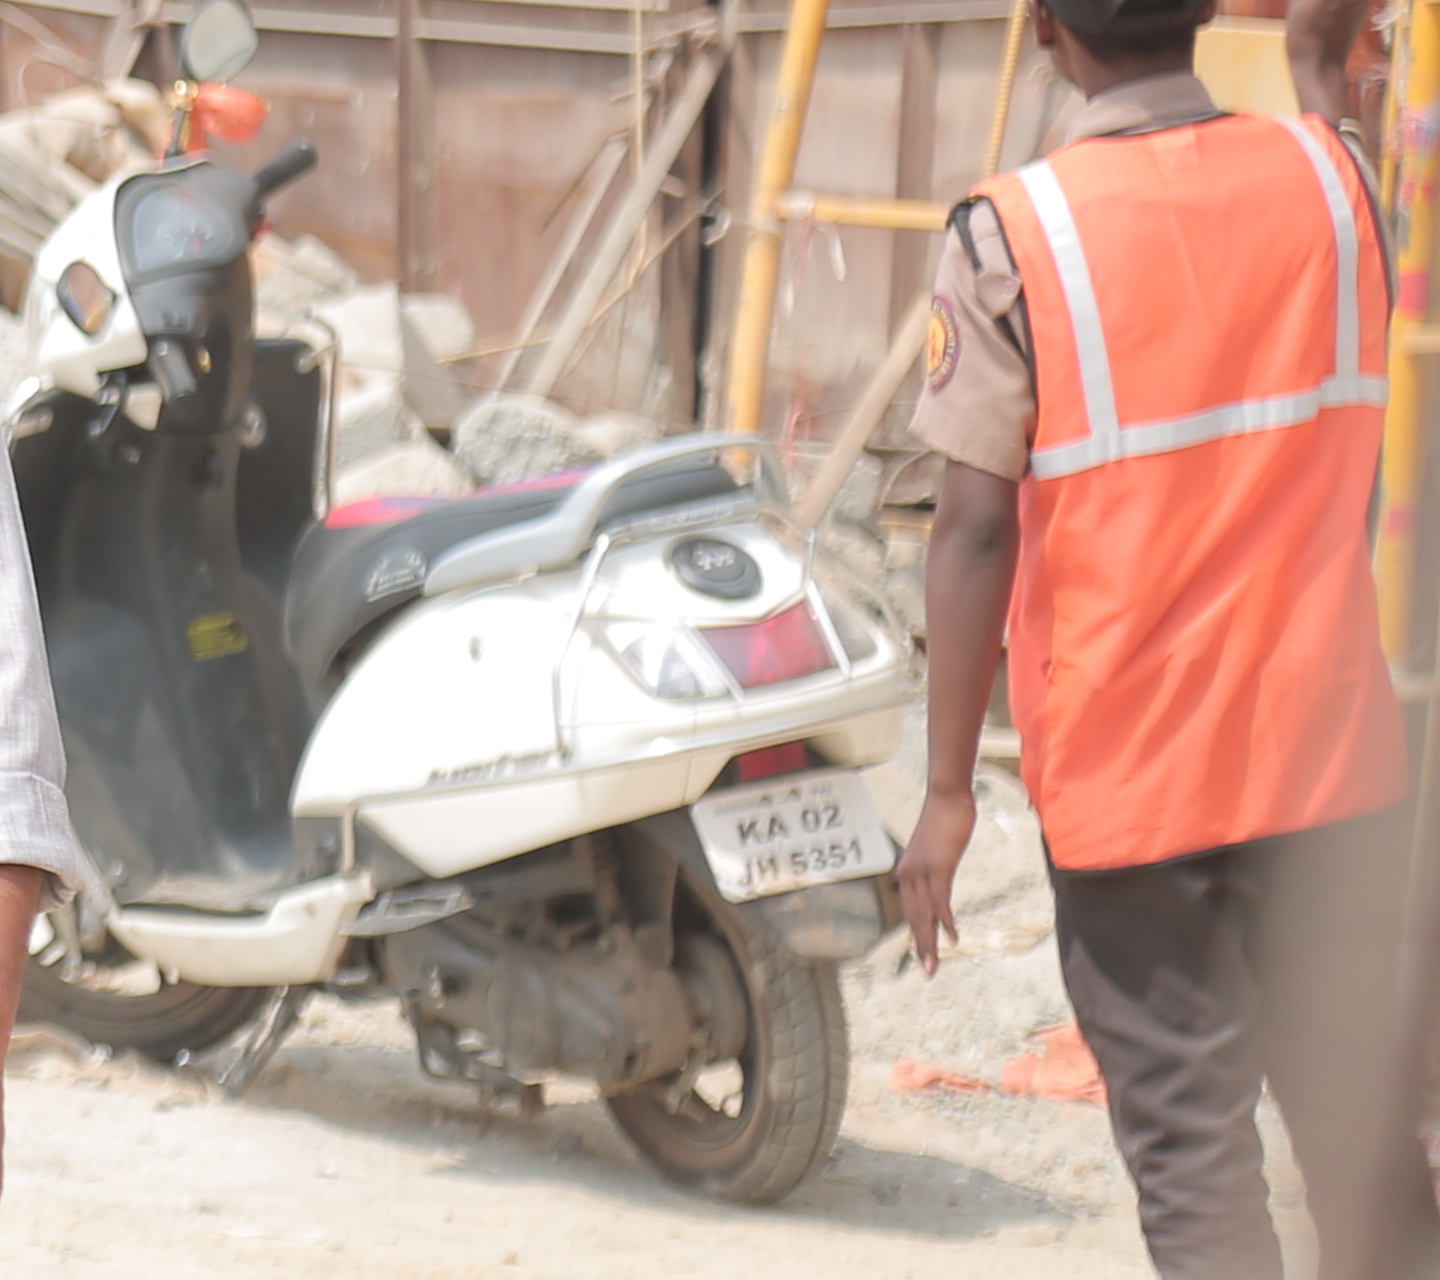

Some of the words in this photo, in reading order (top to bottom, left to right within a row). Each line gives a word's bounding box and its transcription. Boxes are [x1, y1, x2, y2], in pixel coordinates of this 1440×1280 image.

[736, 813, 790, 846] KA
[800, 802, 843, 834] 02
[790, 837, 863, 876] 5351
